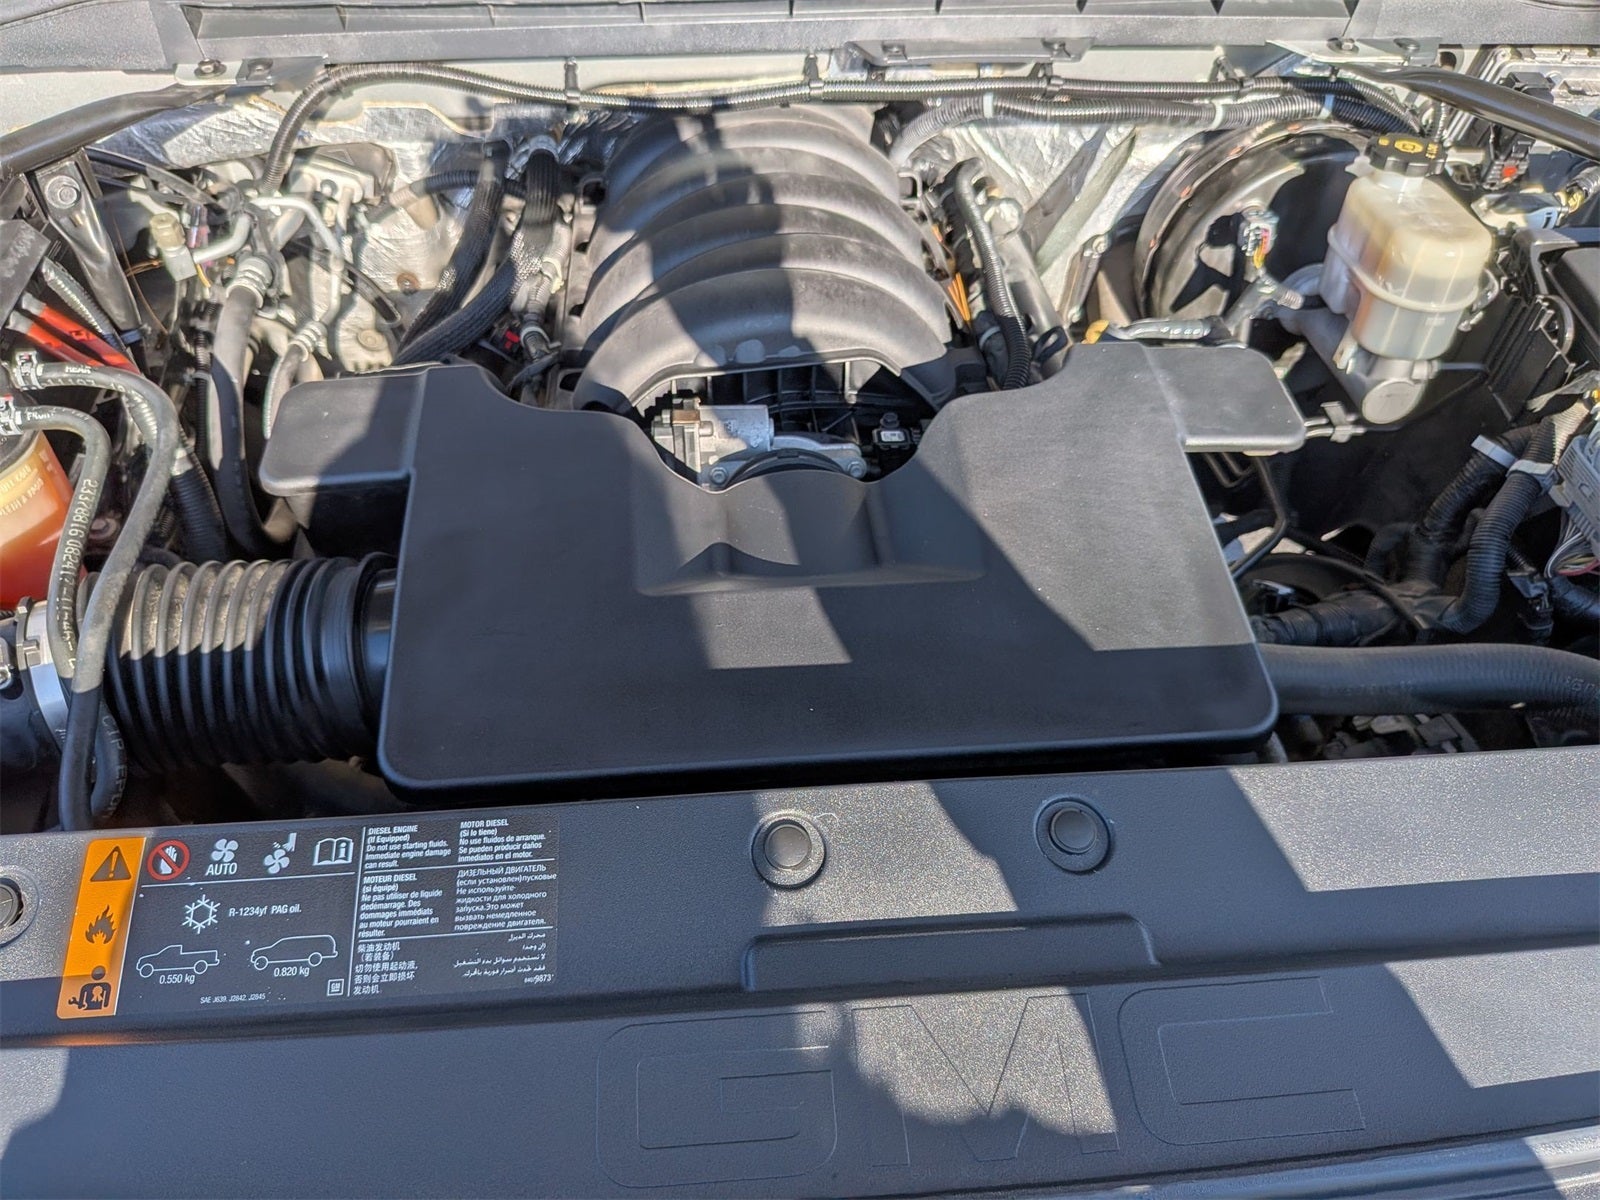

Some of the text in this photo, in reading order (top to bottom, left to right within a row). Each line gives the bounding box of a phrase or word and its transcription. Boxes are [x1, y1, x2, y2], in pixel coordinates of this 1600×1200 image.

[69, 478, 99, 539] 23378816
[460, 818, 509, 829] MOTOR DIESEL
[368, 825, 418, 835] DIESEL ENGINE
[478, 828, 497, 837] tiene)
[376, 834, 410, 844] Equipped)
[459, 838, 468, 846] No
[483, 835, 505, 843] fluidos
[515, 833, 546, 842] arranque.
[367, 844, 376, 852] Do
[377, 843, 388, 851] not
[402, 841, 427, 850] starting
[428, 840, 448, 848] fluids.
[458, 841, 542, 854] Se pueden producir daños
[365, 848, 451, 860] Immediate engine damage
[458, 853, 494, 862] inmediatos
[205, 862, 238, 876] AUTO
[378, 860, 399, 868] result.
[457, 864, 546, 878] ДИЗЕЛЬНЫЙ ДВИГАТЕЛЬ
[363, 873, 417, 884] MOTEUR DIESEL
[456, 879, 476, 887] (если
[362, 883, 398, 893] (si équipé)
[361, 889, 443, 902] Ne pas utiliser de liquide
[456, 891, 547, 904] жидкости для холодного
[228, 904, 302, 917] R-1234yf PAG oil.
[360, 908, 433, 920] dommages immédiats
[455, 910, 537, 922] вызвать немедленное
[369, 920, 393, 928] moteur
[394, 917, 429, 927] pourraient
[454, 918, 546, 931] повреждение двигателя.
[358, 929, 385, 938] résulter.
[357, 941, 400, 953] 柴油发动机
[274, 966, 310, 977] 0.820 kg
[354, 971, 415, 984] 否则会立即损坏
[159, 973, 196, 985] 0.550 kg
[199, 996, 211, 1004] SAE
[596, 976, 1366, 1189] GMC
